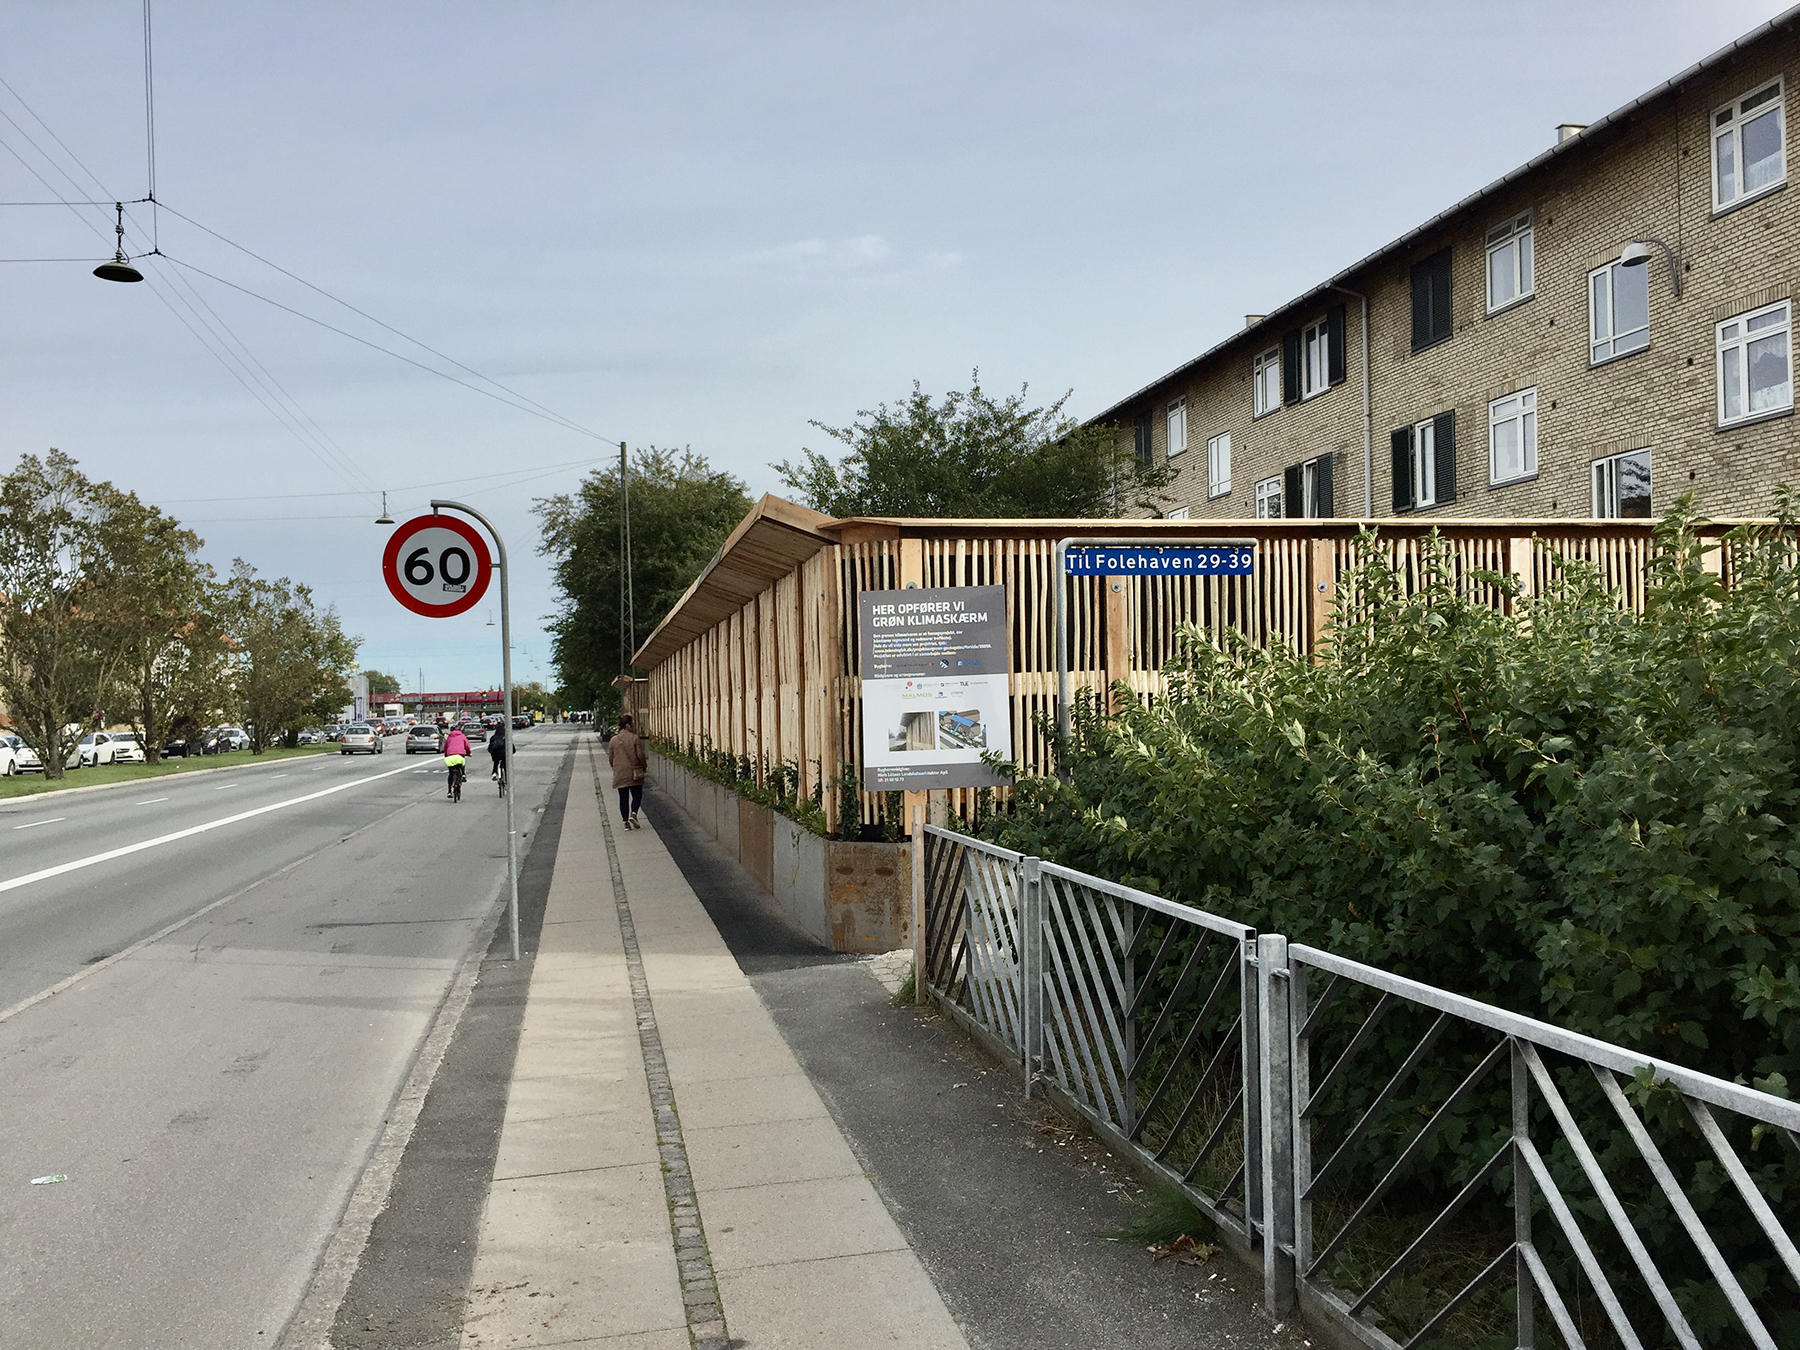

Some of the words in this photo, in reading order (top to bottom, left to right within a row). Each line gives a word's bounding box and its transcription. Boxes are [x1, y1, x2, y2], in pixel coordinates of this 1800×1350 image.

[404, 546, 471, 586] 60
[1066, 554, 1091, 569] Til
[1096, 554, 1193, 569] Folehaven
[1197, 553, 1252, 569] 29-39
[872, 604, 896, 615] HER
[897, 601, 951, 614] OPFØRER
[952, 601, 965, 611] VI
[872, 616, 905, 627] GRØN
[907, 612, 988, 626] KLIMASKÆRM
